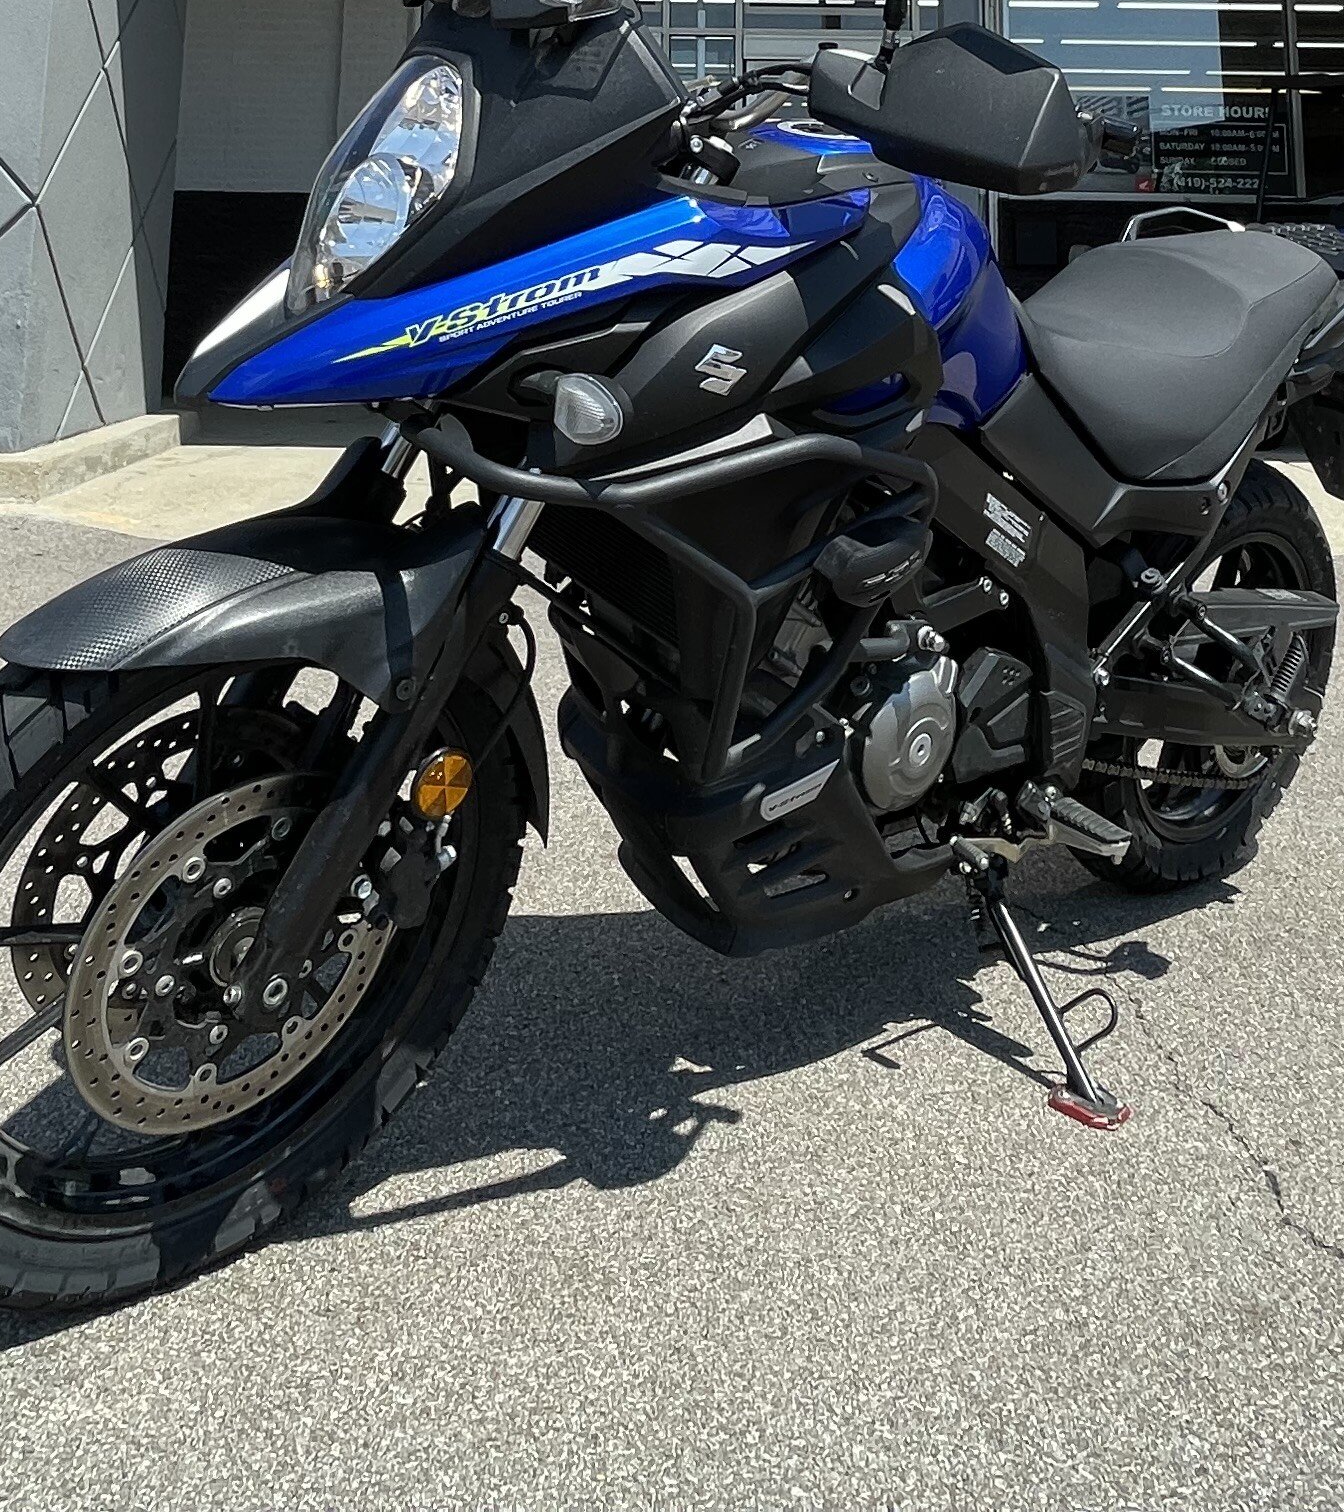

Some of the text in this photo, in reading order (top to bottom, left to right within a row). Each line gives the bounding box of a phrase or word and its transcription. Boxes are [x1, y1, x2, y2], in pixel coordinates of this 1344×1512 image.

[1161, 104, 1214, 117] STORE
[1159, 142, 1205, 151] SATURDAY
[439, 291, 583, 343] SPORT ADVENTURE TOURER
